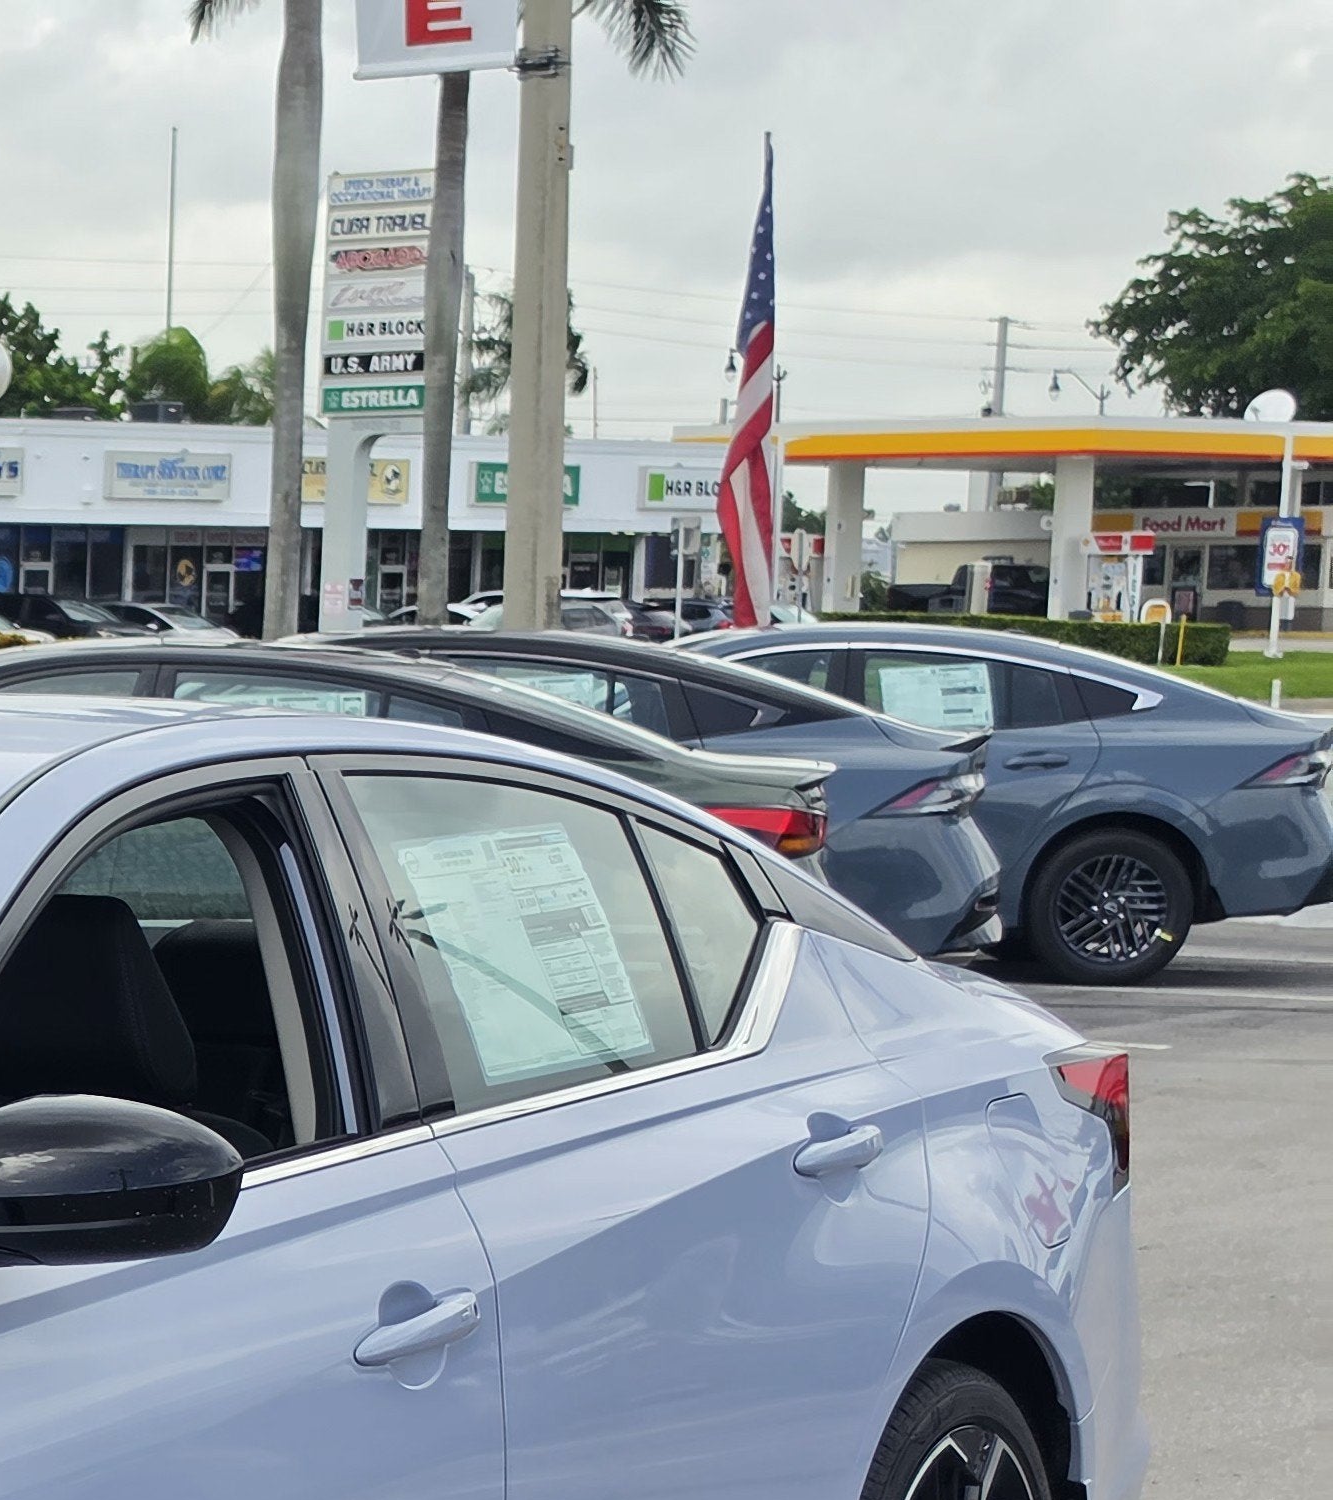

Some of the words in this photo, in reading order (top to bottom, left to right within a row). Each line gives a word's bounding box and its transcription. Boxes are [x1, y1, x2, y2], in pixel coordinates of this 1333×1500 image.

[330, 216, 371, 236] CUBA
[375, 213, 432, 233] TRAVEL
[345, 321, 375, 337] H&R
[379, 320, 426, 335] BLOCK
[330, 356, 366, 374] U.S.
[369, 352, 417, 372] ARMY
[341, 388, 419, 408] ESTRELLA
[666, 480, 693, 496] H&R
[695, 481, 721, 497] BLO
[1141, 515, 1182, 532] Food
[1185, 515, 1226, 532] Mart
